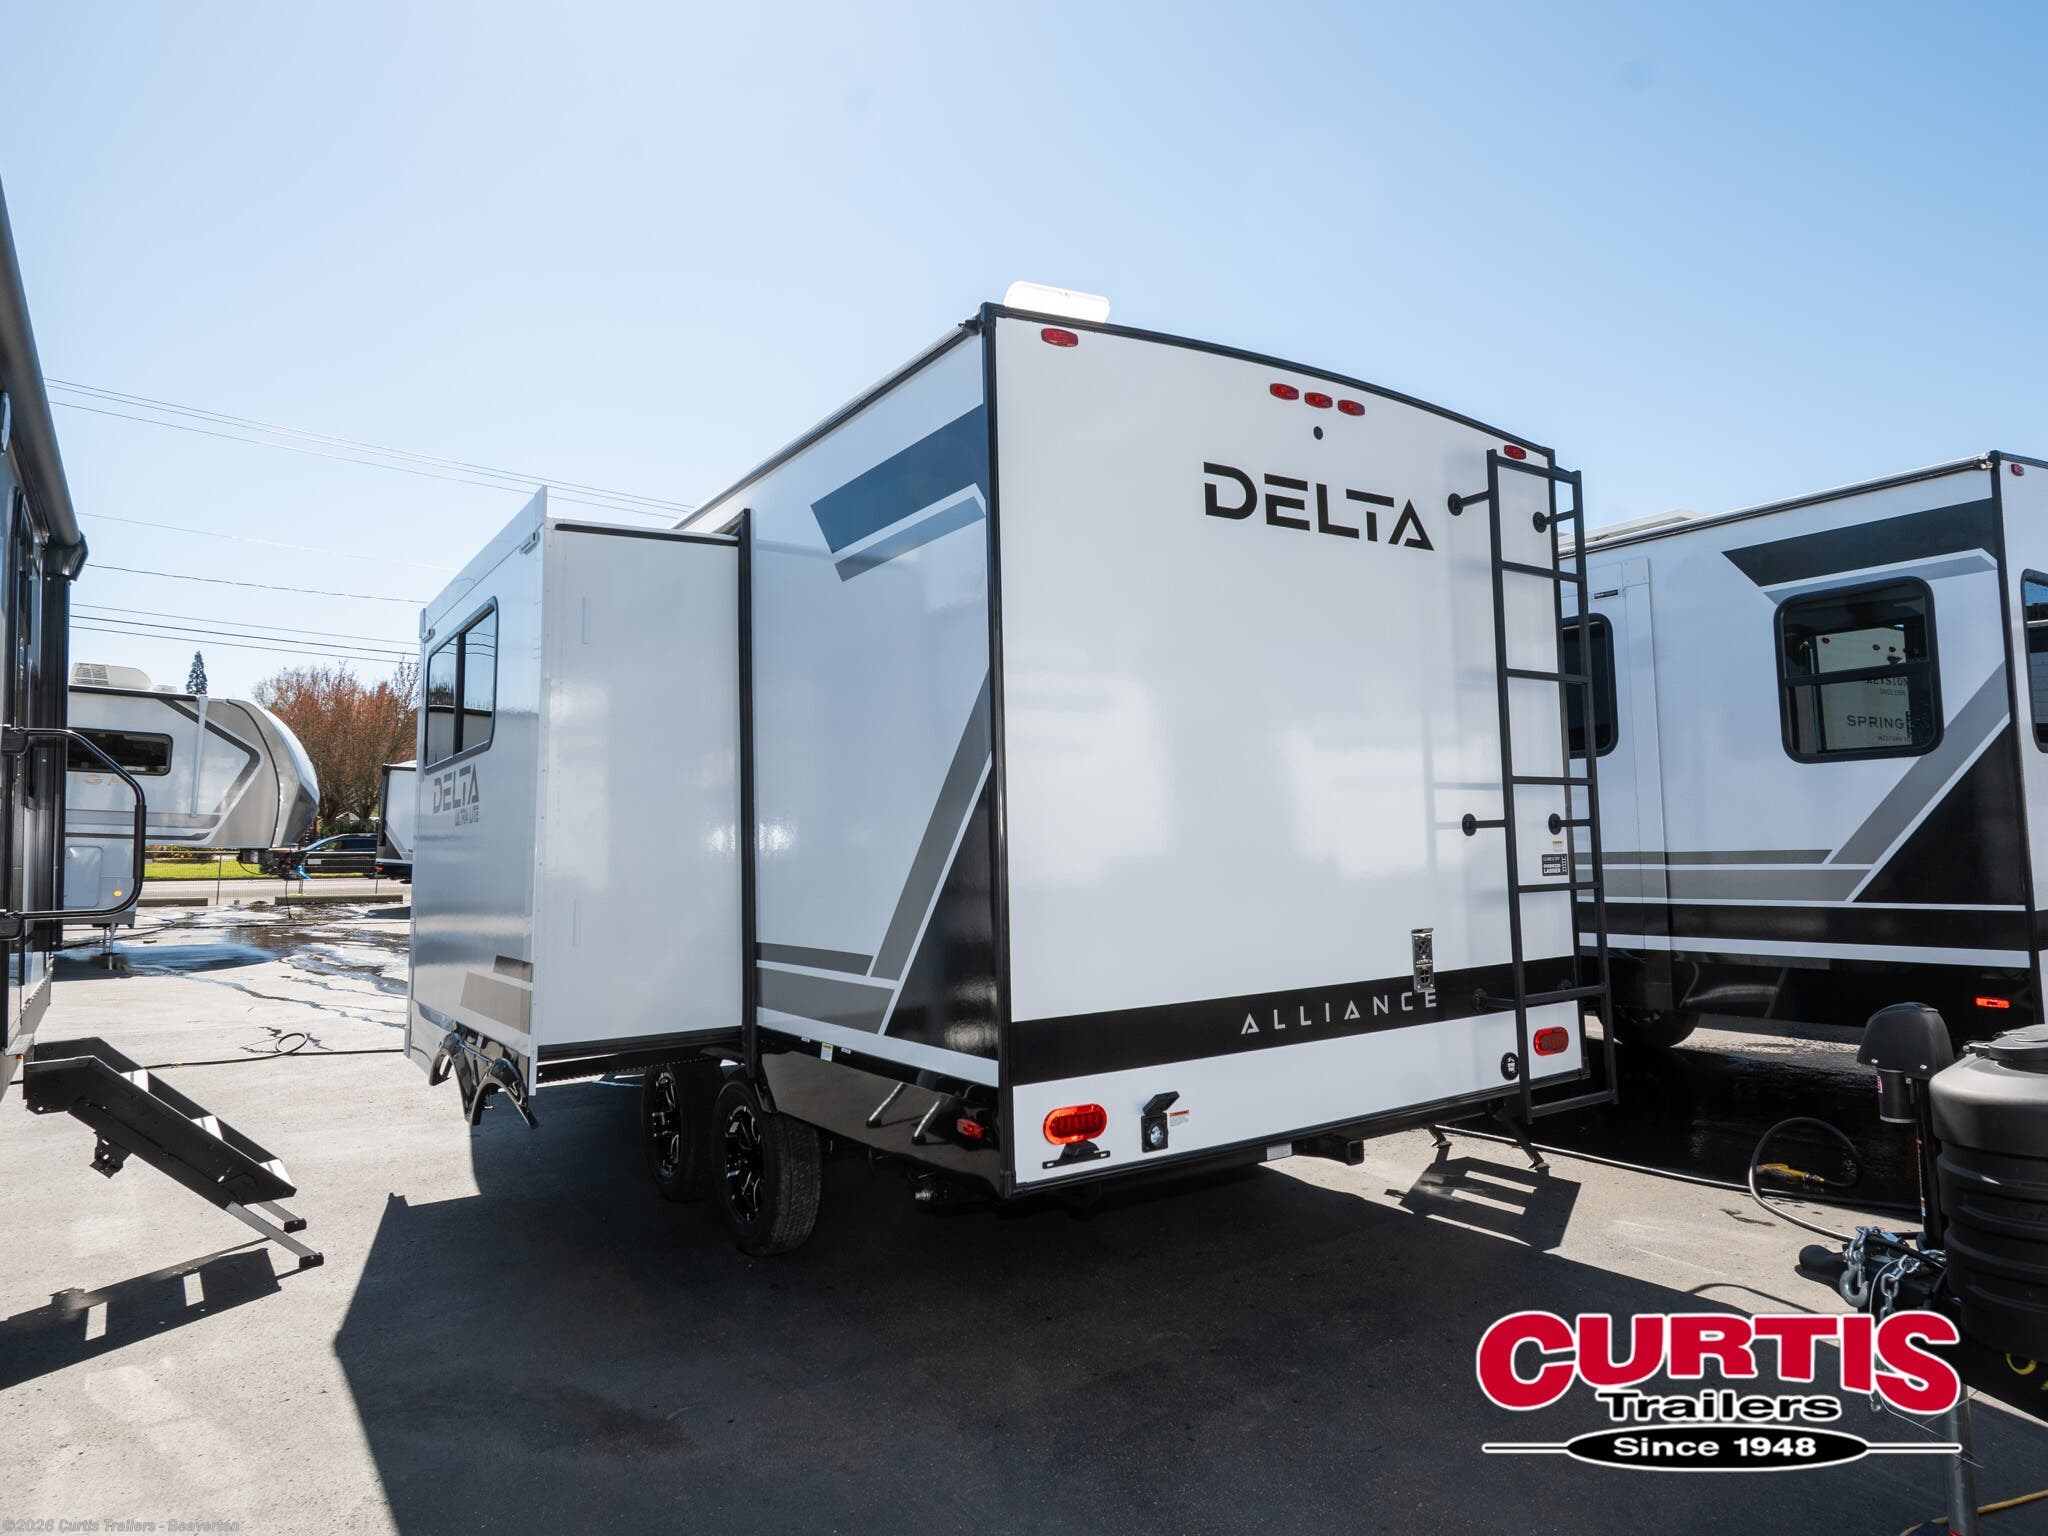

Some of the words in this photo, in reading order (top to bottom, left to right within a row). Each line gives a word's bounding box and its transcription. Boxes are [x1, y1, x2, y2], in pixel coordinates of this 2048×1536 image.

[1203, 461, 1435, 551] DELTA
[433, 763, 480, 814] DELTA
[1240, 988, 1438, 1035] ALLIANCE
